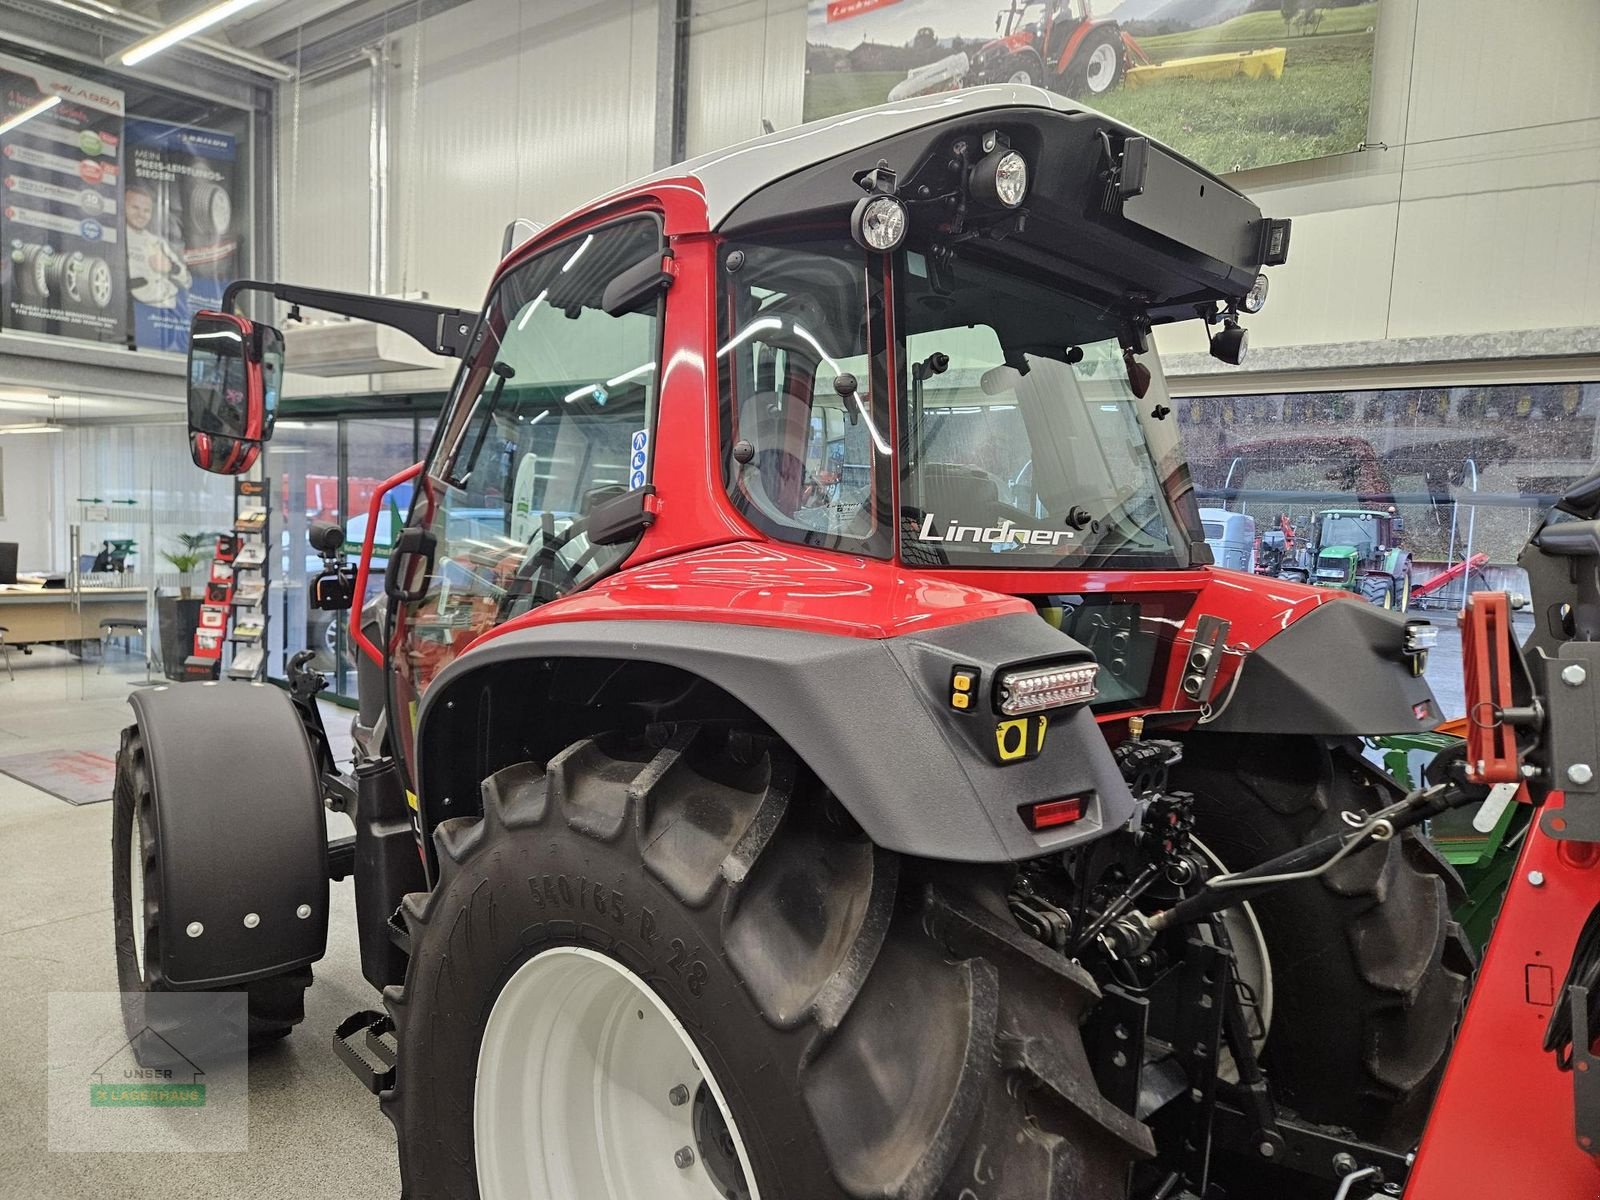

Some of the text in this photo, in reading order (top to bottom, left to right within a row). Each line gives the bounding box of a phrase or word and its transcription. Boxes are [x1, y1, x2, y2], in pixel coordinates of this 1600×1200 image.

[134, 149, 160, 161] MEIN
[918, 513, 1074, 546] Lindner
[667, 937, 709, 999] 28
